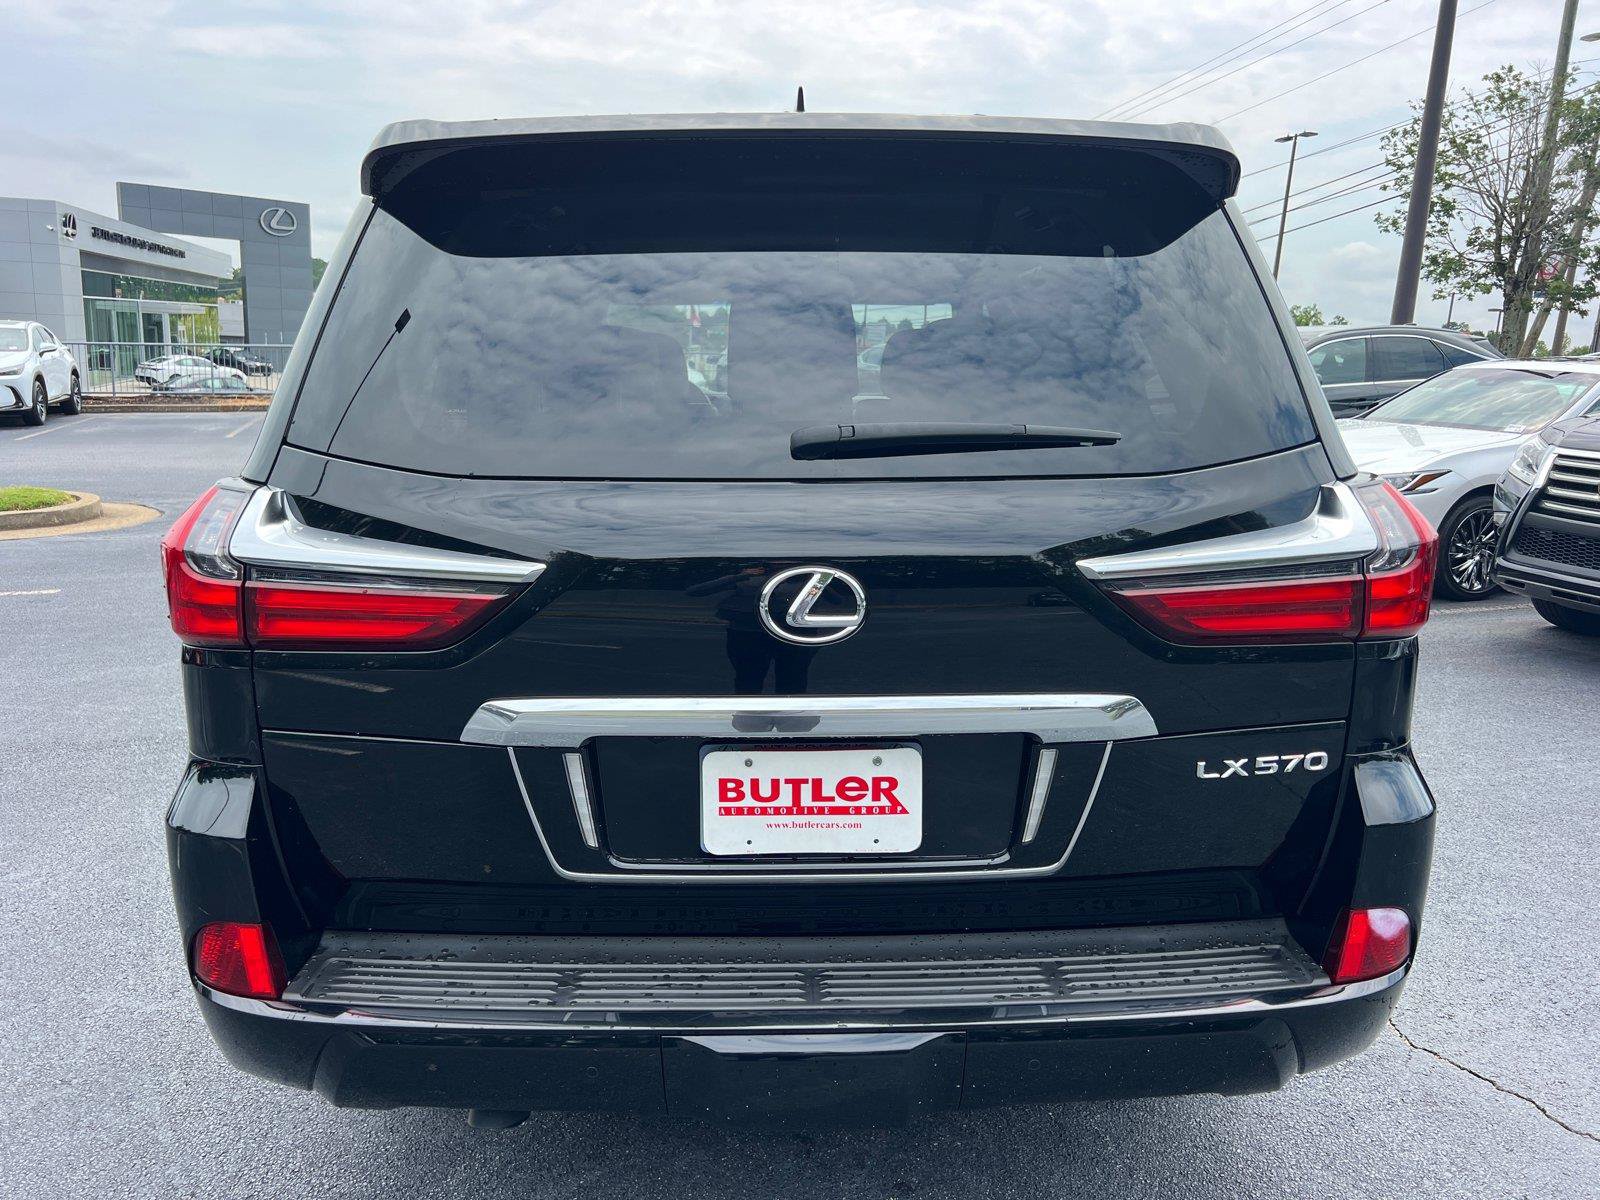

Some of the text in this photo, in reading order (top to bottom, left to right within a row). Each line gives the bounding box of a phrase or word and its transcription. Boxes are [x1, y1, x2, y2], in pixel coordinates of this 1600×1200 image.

[719, 805, 904, 815] AUTOMOTIVE GROUP
[766, 820, 862, 830] www.butlercars.com
